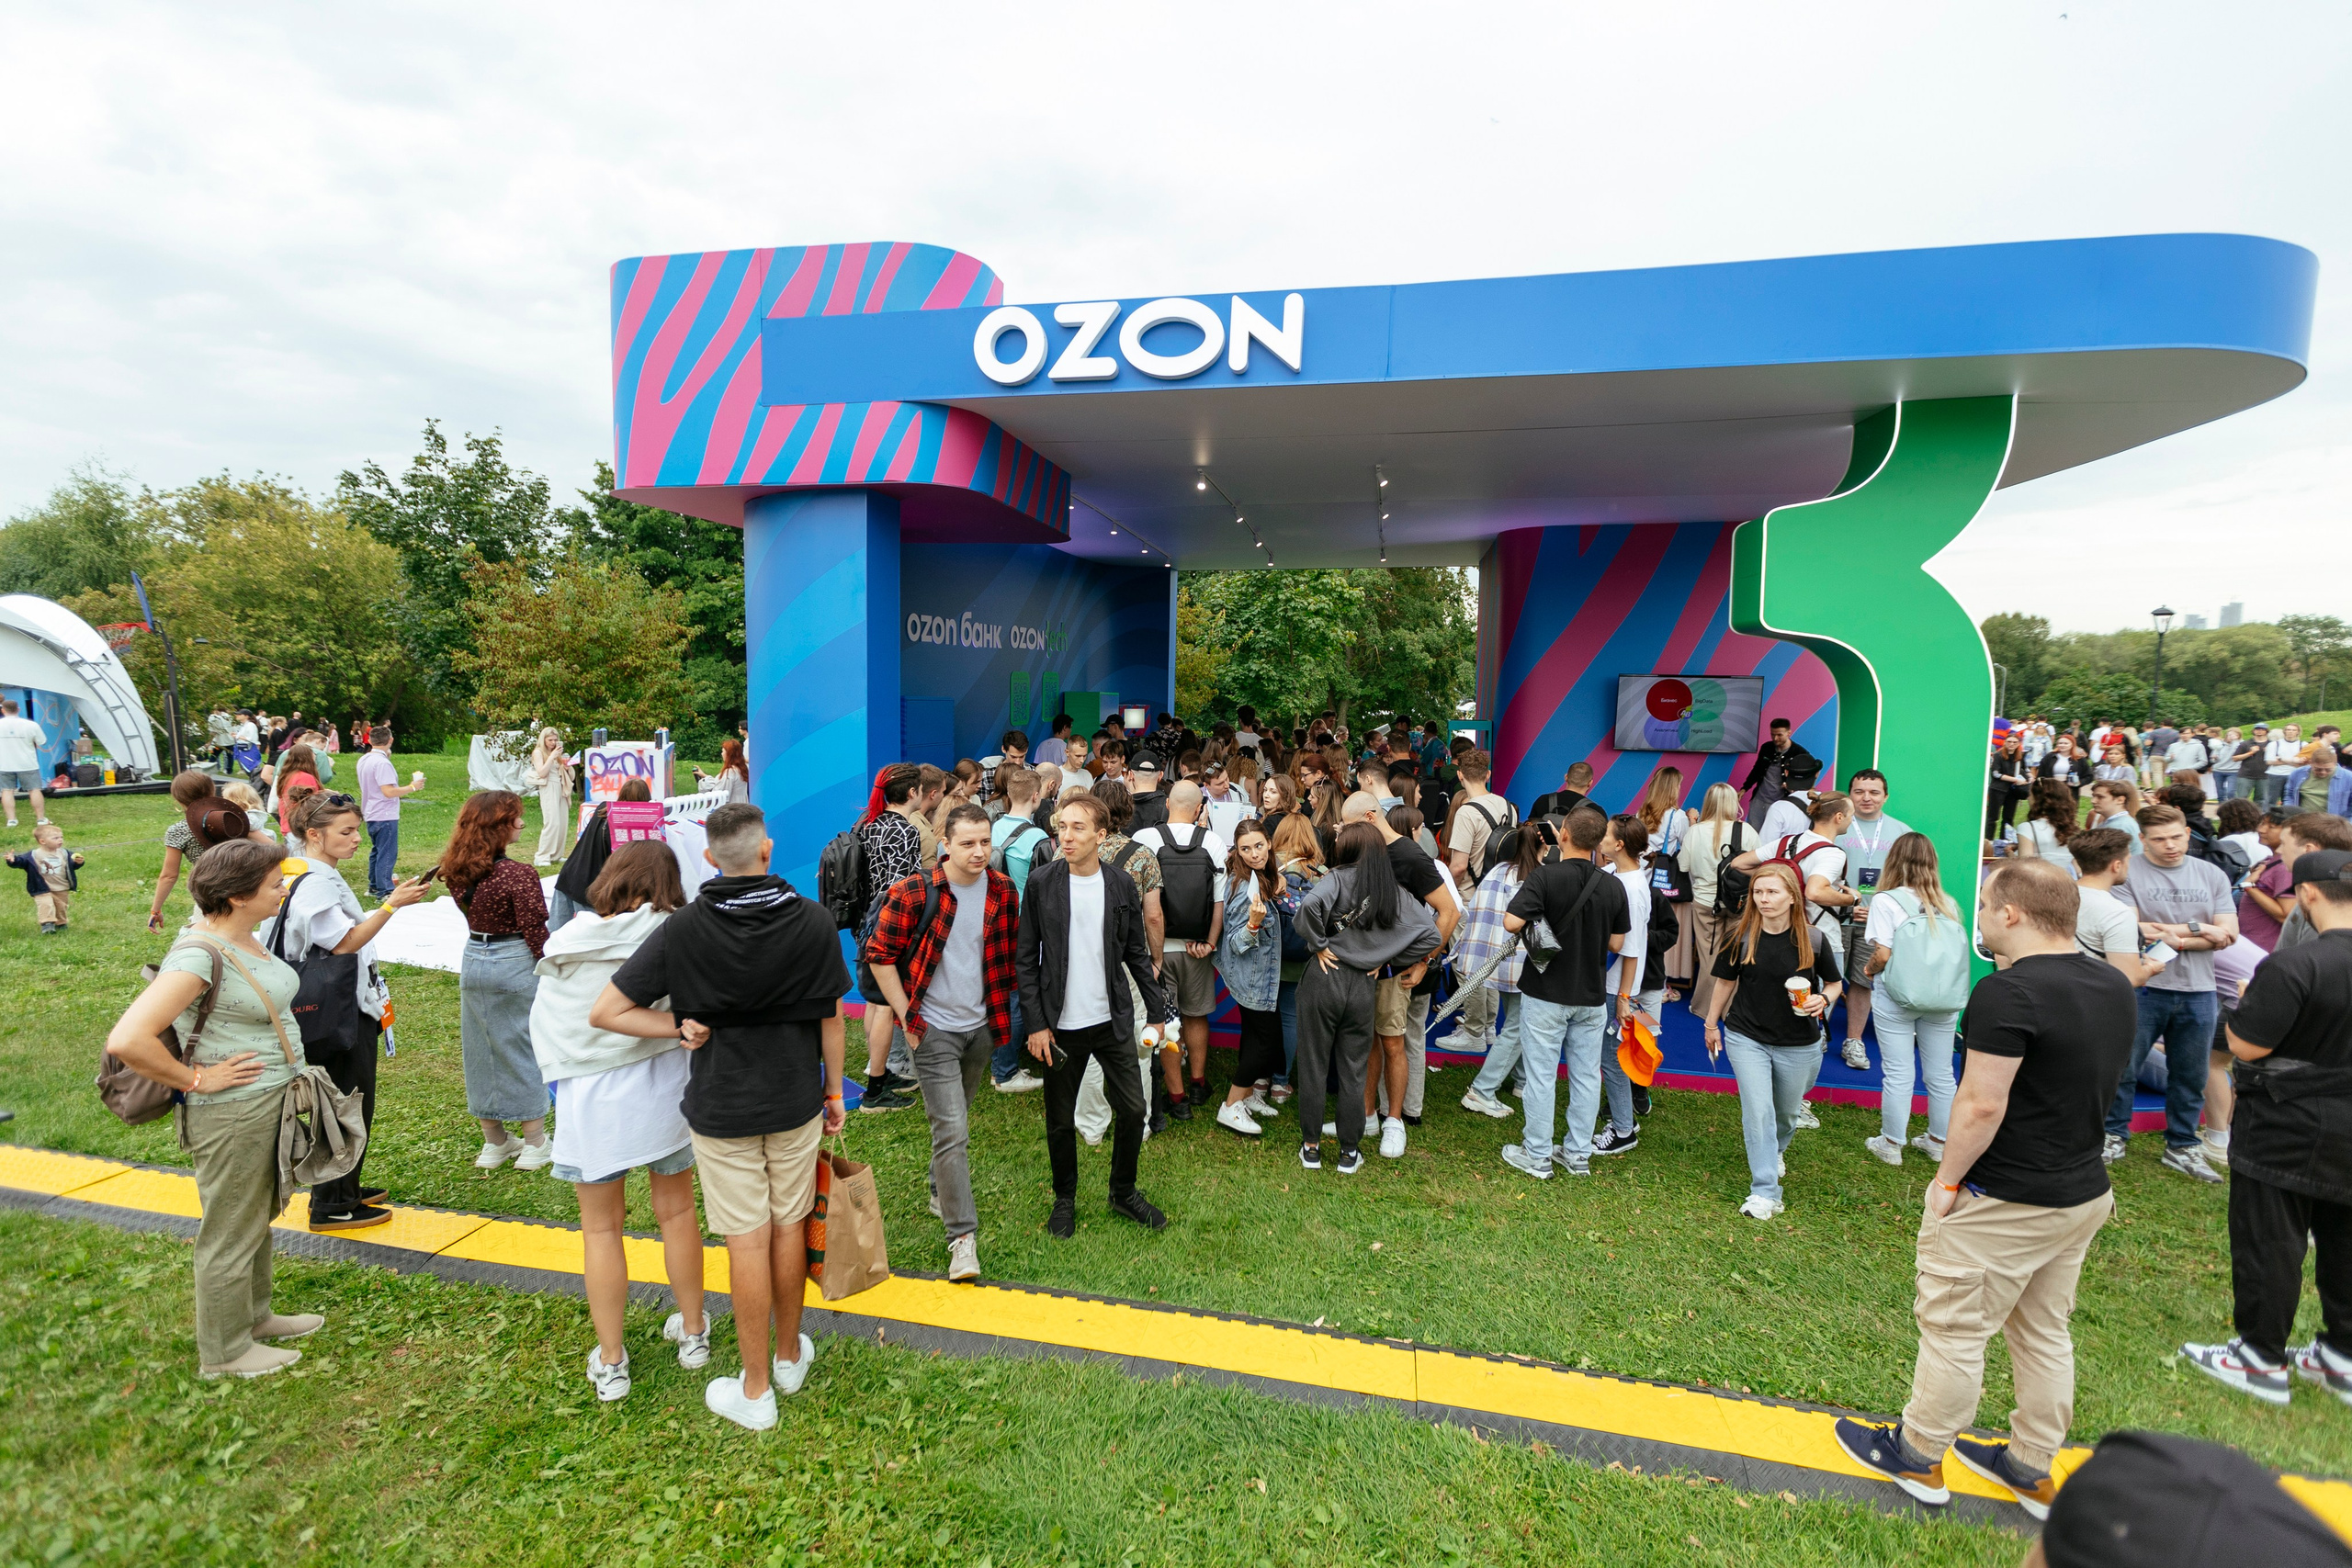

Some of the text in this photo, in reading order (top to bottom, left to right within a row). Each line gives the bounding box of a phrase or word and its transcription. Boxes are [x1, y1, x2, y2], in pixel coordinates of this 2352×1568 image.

[973, 292, 1305, 386] OZON
[907, 611, 1002, 649] ozon банк
[589, 751, 655, 779] OZON
[290, 1004, 319, 1014] OURG
